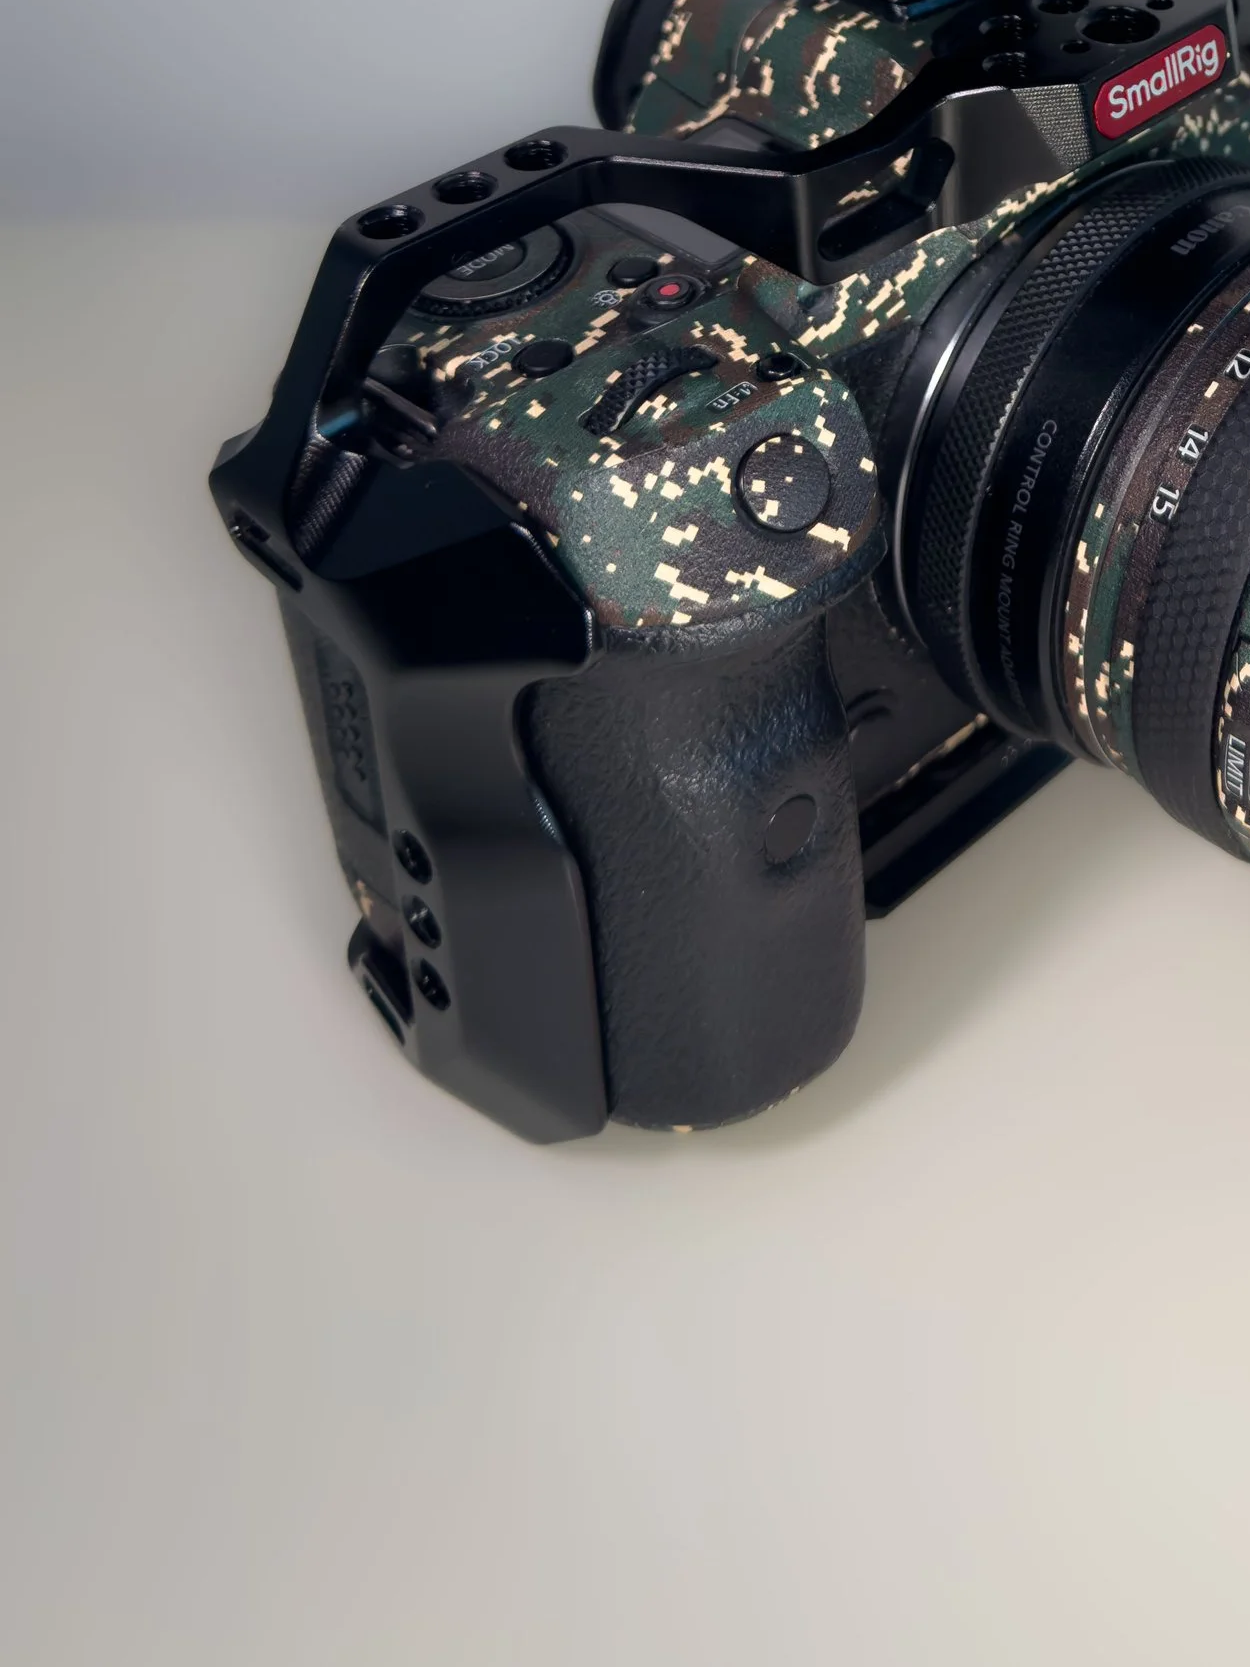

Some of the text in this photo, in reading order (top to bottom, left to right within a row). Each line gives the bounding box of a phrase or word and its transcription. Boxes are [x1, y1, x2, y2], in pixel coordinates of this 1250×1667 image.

[1108, 39, 1219, 119] SmallRig
[1178, 428, 1208, 459] 14
[997, 419, 1057, 646] CONTROL RING MOUNT
[1152, 485, 1181, 520] 15
[1226, 734, 1246, 797] LIMIT
